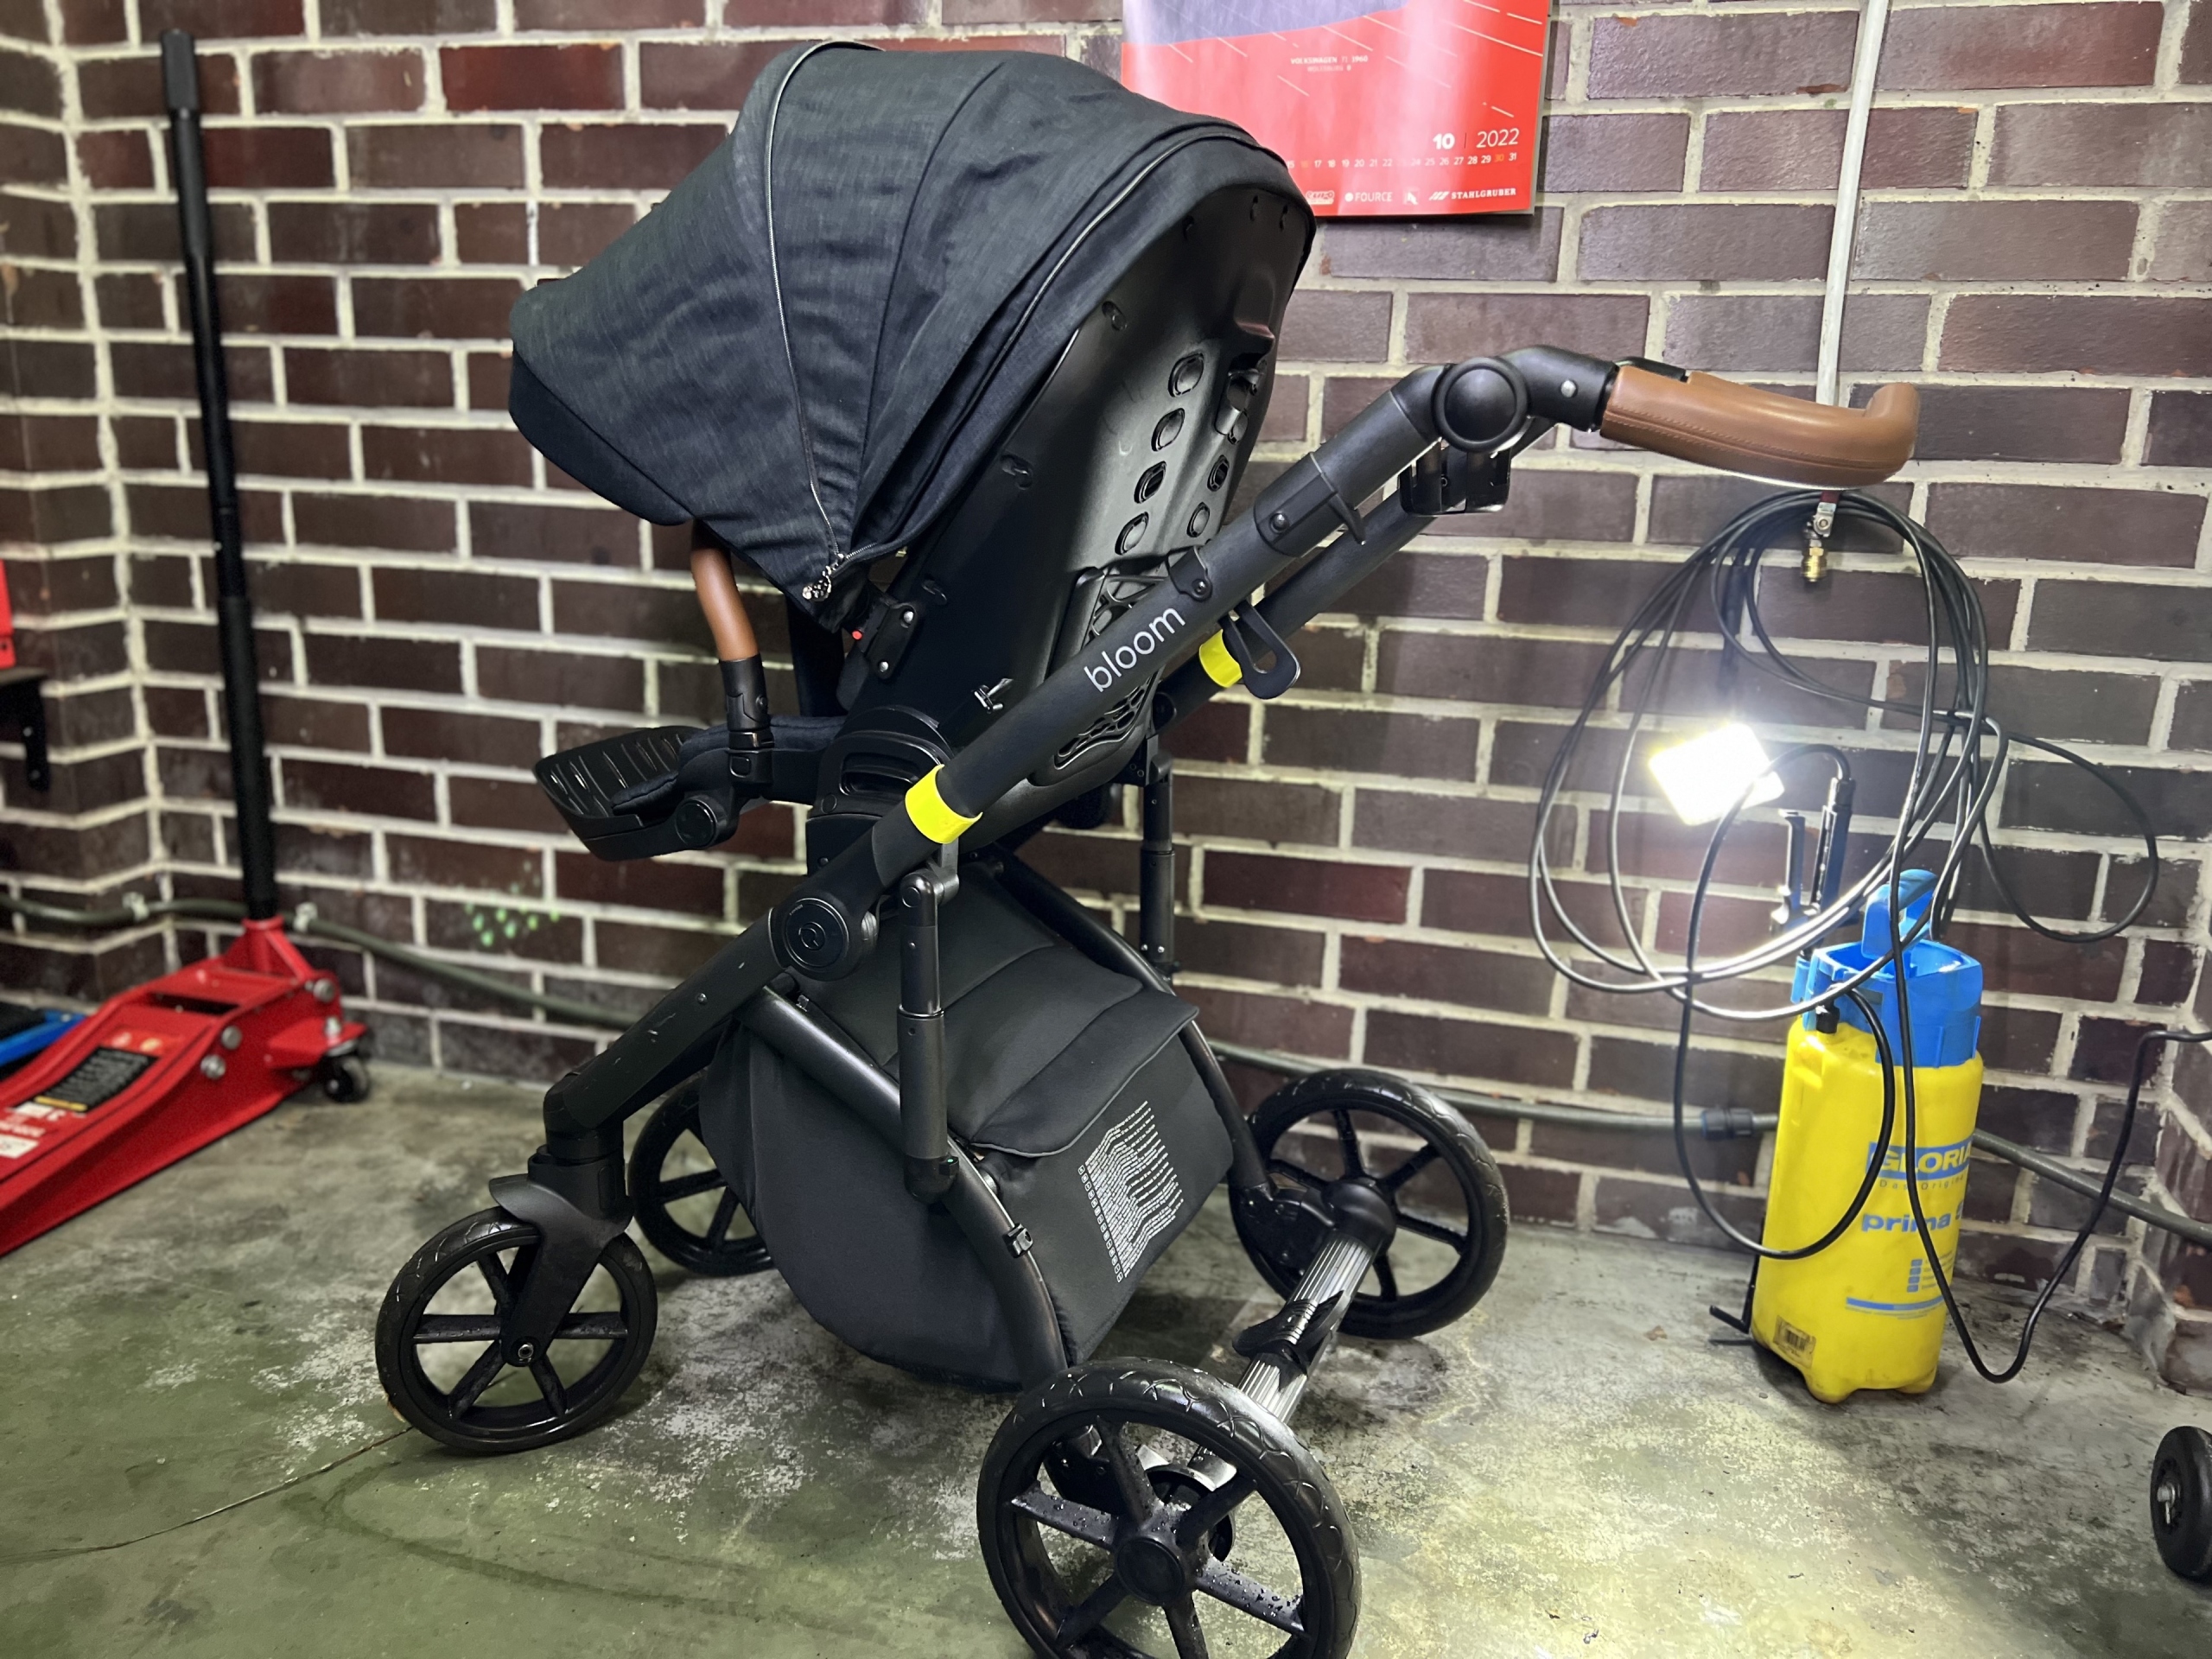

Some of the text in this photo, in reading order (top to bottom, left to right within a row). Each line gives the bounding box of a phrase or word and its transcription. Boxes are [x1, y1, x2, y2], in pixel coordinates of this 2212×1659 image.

[1290, 56, 1338, 65] VOLKSWAGEN
[1351, 54, 1369, 63] 1960
[1433, 128, 1520, 149] 10 2022
[1314, 159, 1323, 168] 17
[1327, 159, 1336, 168] 18
[1341, 158, 1350, 168] 19
[1354, 158, 1365, 168] 20
[1369, 158, 1378, 168] 21
[1382, 158, 1393, 168] 22
[1425, 157, 1435, 167] 25
[1439, 157, 1450, 167] 26
[1453, 156, 1465, 166] 27
[1467, 156, 1478, 165] 28
[1481, 155, 1491, 164] 29
[1494, 154, 1504, 163] 30
[1509, 152, 1517, 162] 31
[1354, 191, 1393, 202] FOURCE
[1451, 188, 1516, 200] STAHLGRUBER
[1084, 607, 1186, 692] bloom
[1861, 1212, 1952, 1232] prima
